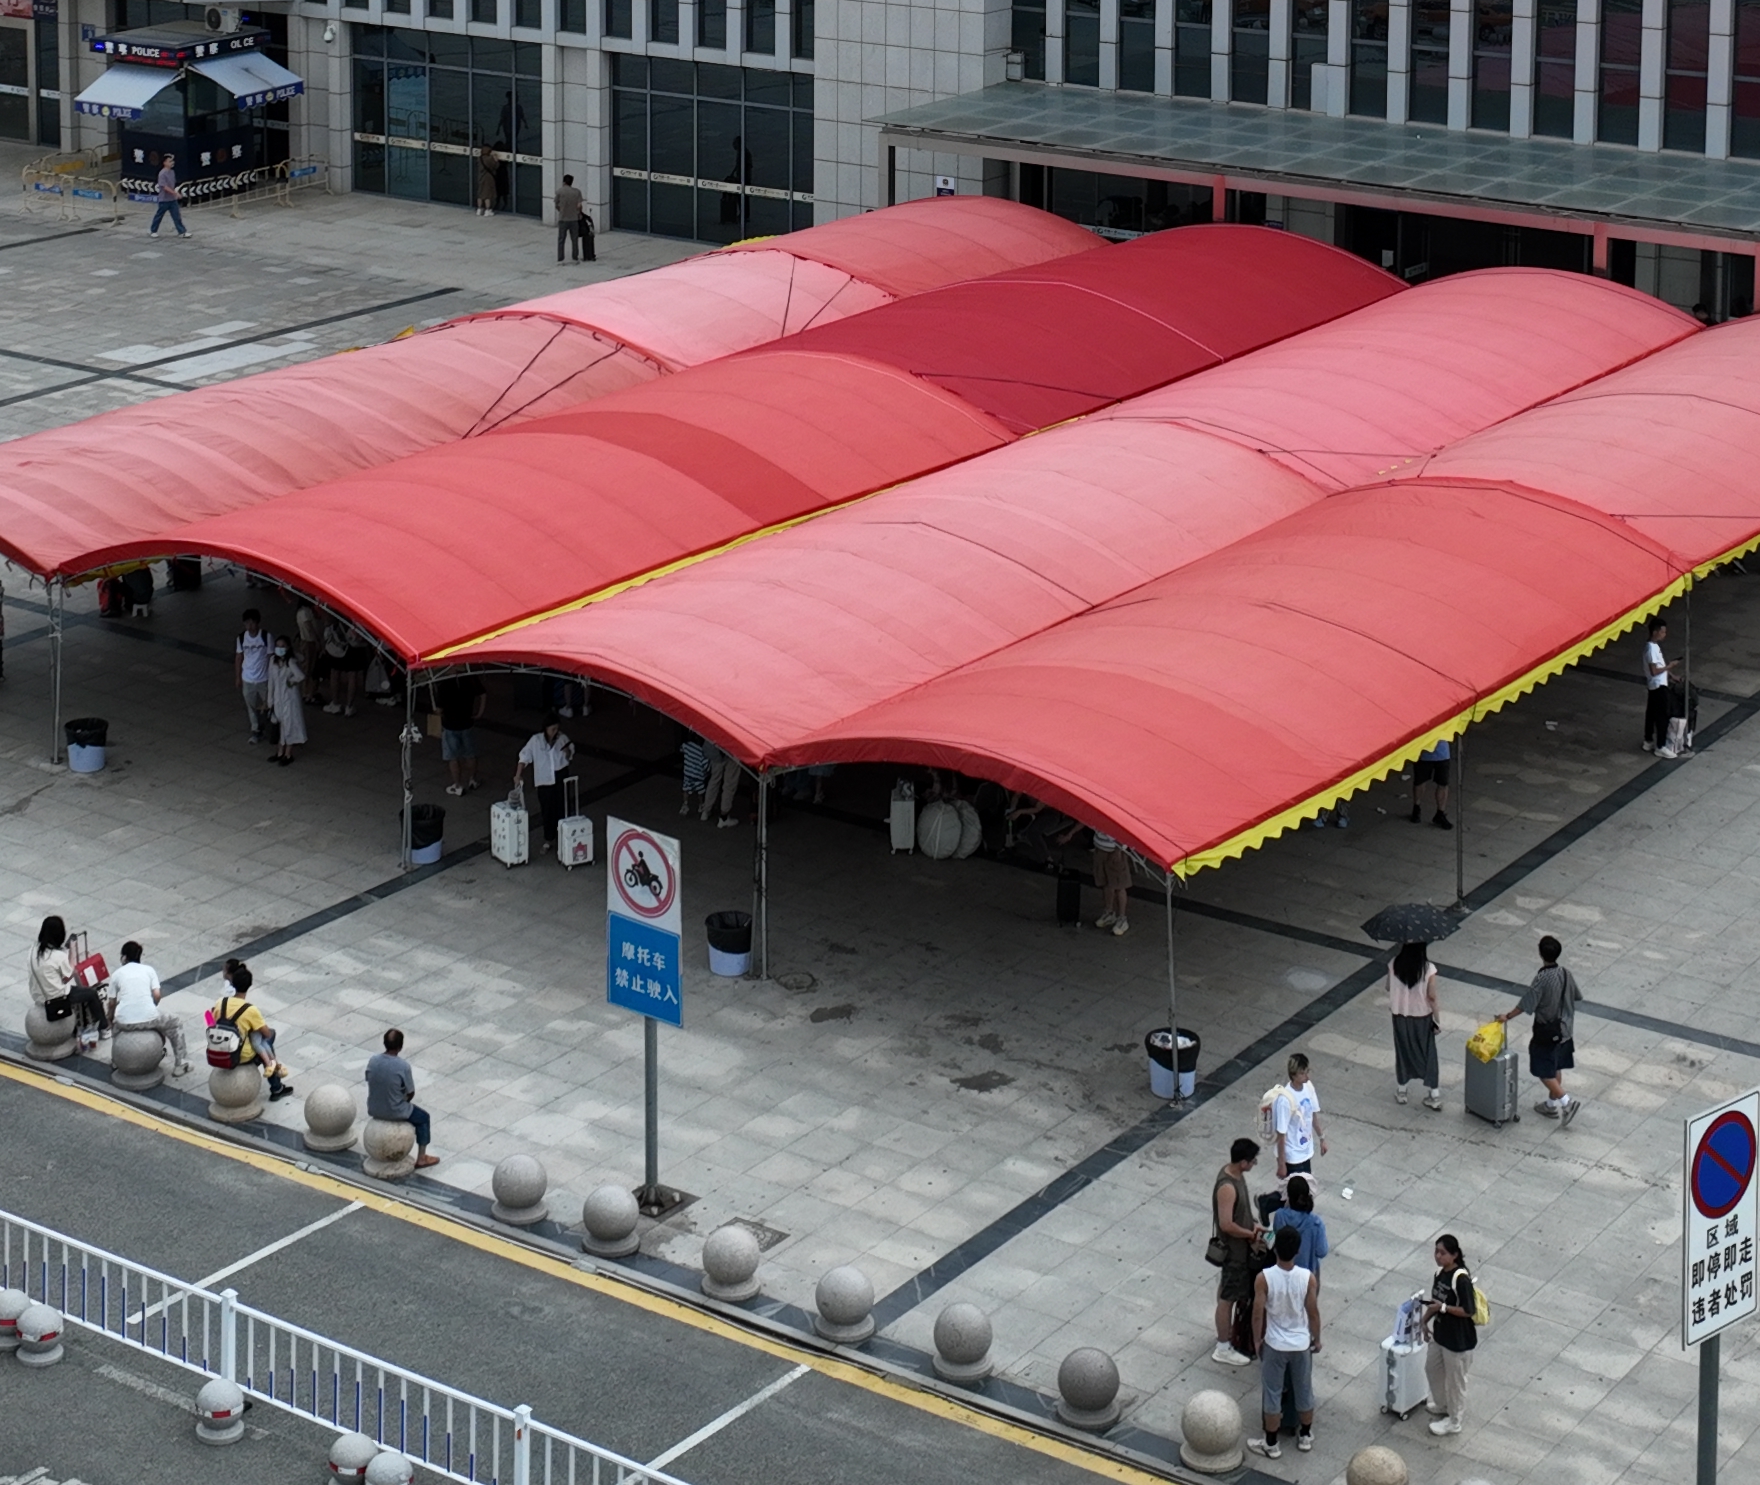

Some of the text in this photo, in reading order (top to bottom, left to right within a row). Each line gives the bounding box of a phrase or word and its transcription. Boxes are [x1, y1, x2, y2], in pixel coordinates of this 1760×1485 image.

[131, 46, 160, 58] POLICE
[622, 941, 665, 971] 摩托车
[615, 967, 678, 1005] 禁止驶入
[1707, 1214, 1738, 1249] 区域
[1692, 1236, 1753, 1289] 即停即走
[1692, 1271, 1753, 1327] 违者处罚
